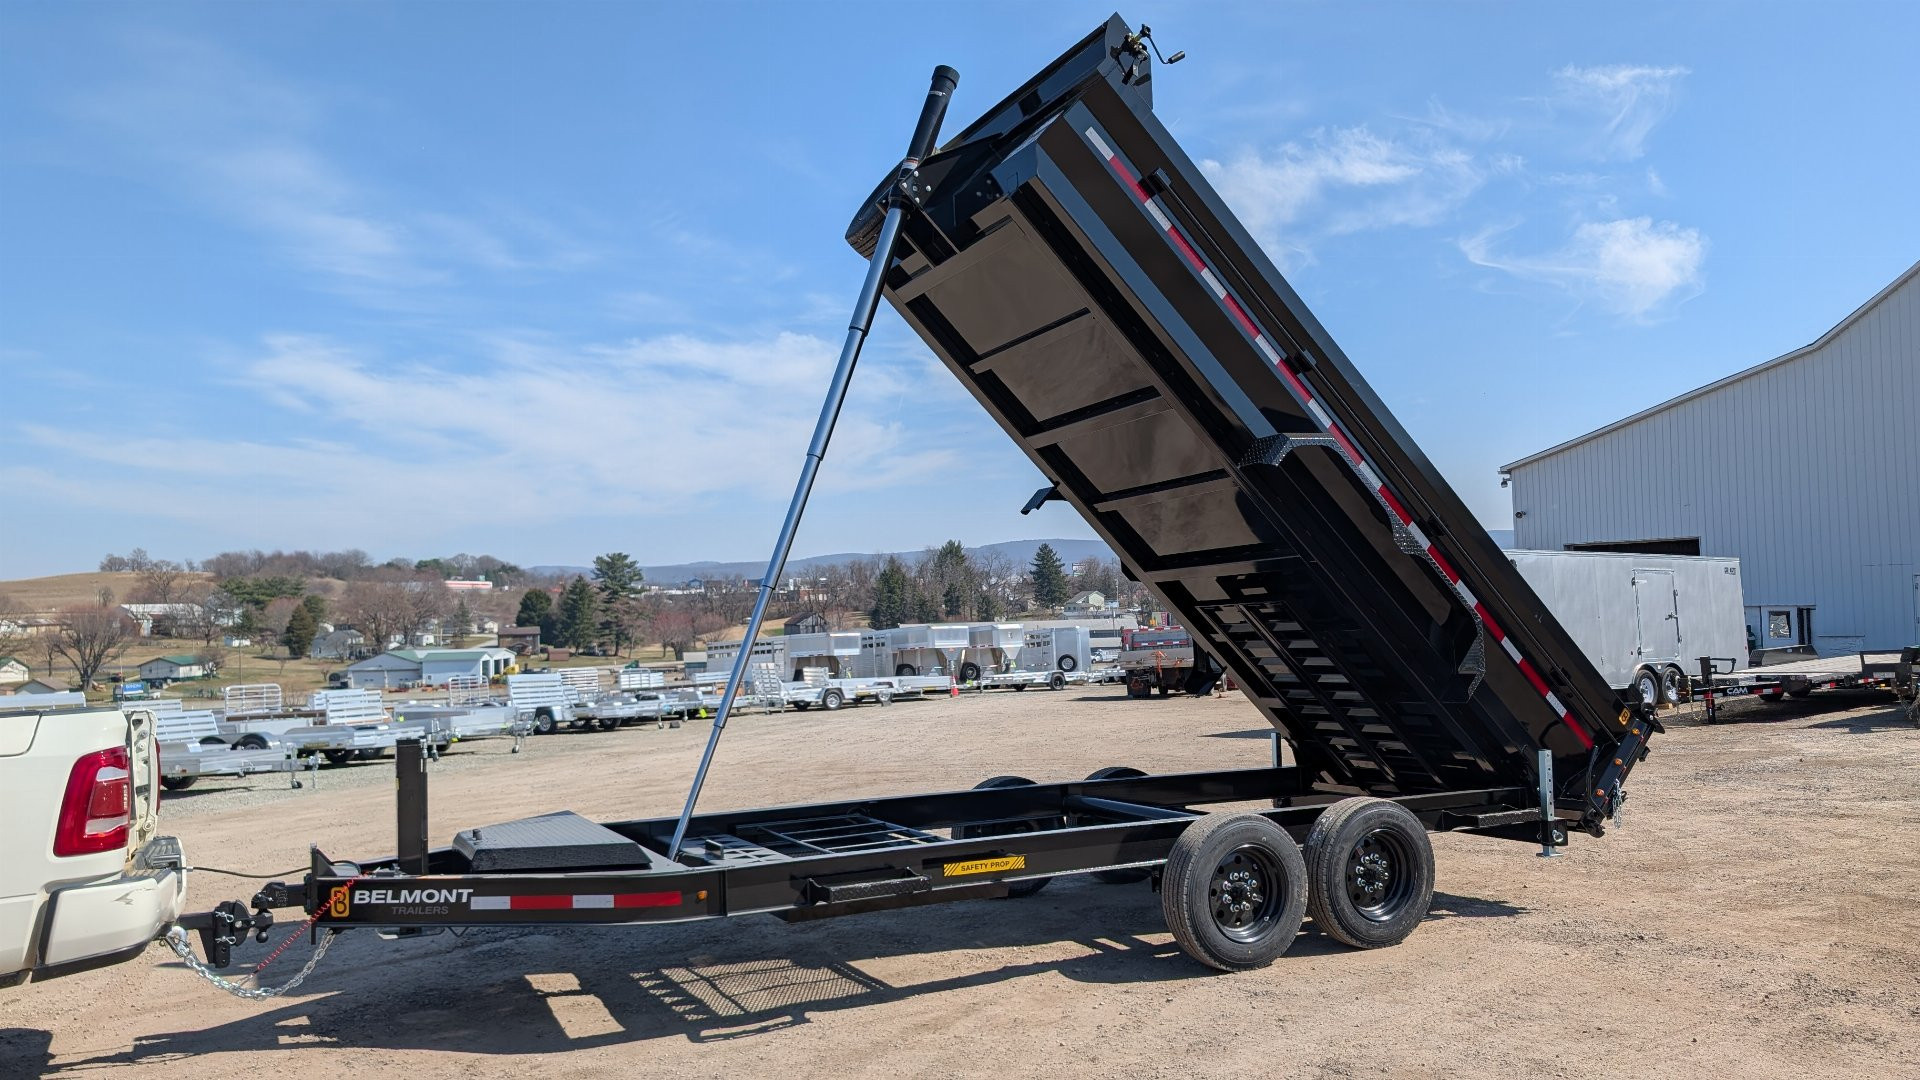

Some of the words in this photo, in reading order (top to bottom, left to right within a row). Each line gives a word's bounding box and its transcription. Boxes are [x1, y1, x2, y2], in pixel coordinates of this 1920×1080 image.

[1727, 687, 1748, 695] CAM
[961, 863, 988, 872] SAFETY
[354, 889, 473, 904] BELMONT
[392, 906, 448, 915] TRAILERS
